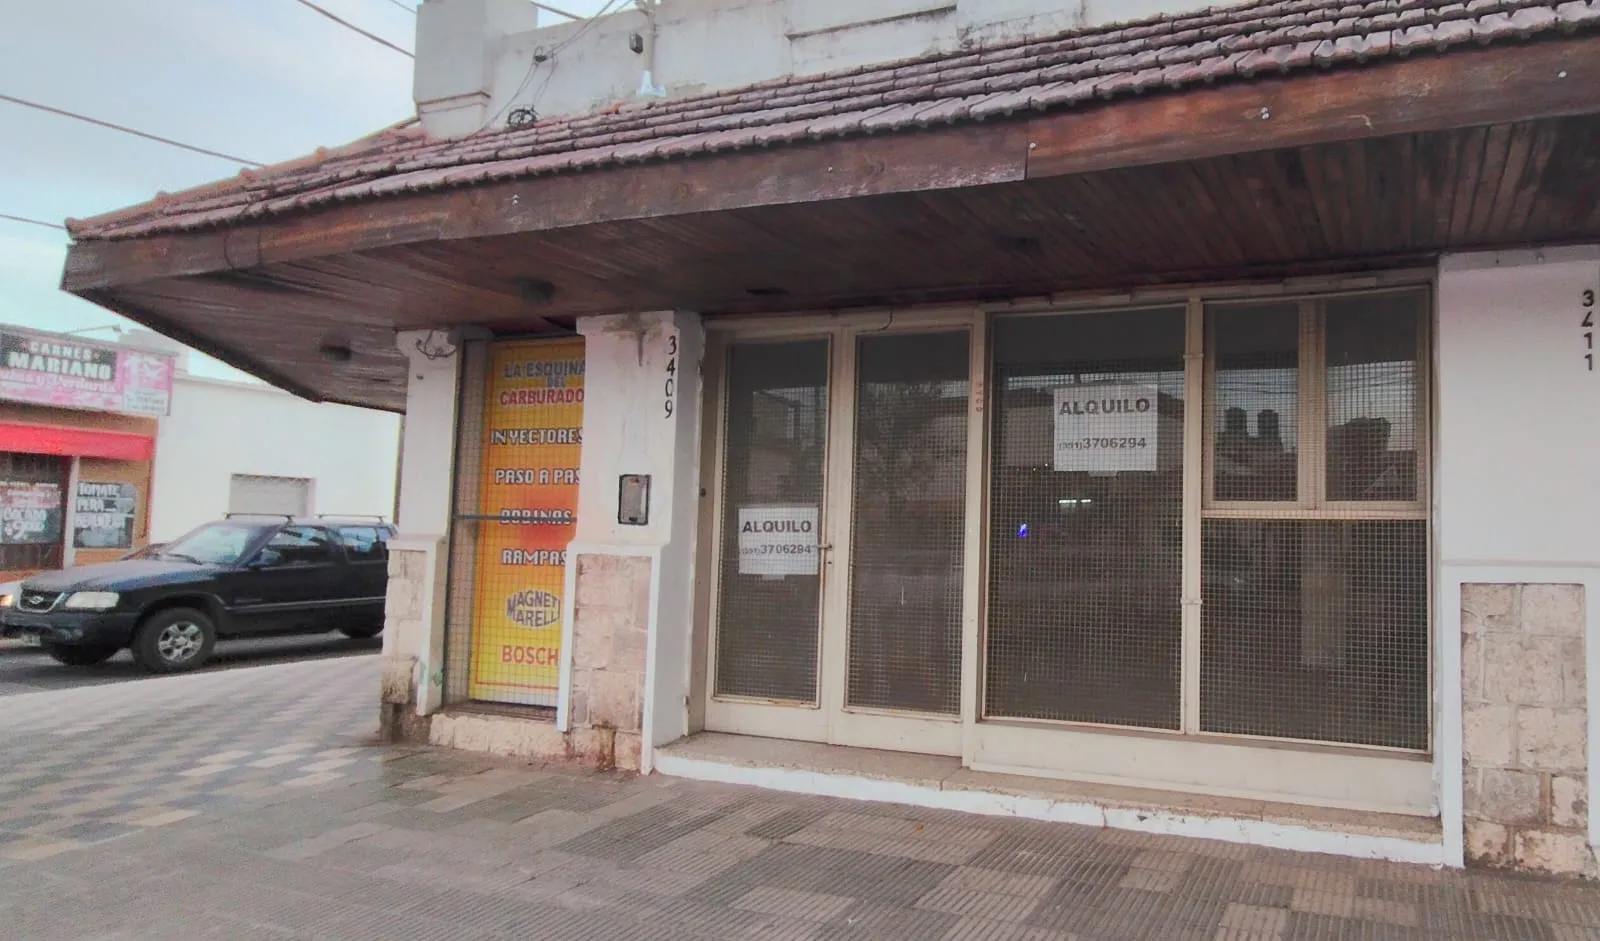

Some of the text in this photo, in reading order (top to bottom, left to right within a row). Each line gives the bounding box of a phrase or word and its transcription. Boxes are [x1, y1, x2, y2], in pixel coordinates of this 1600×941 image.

[1580, 289, 1594, 371] 3411
[29, 341, 92, 361] CARNES
[8, 351, 112, 380] MARIANO
[503, 362, 521, 378] LA
[664, 335, 677, 419] 3409
[1059, 399, 1150, 416] ALQUILO
[495, 468, 534, 485] PASO
[539, 469, 549, 484] A
[742, 520, 812, 533] ALQUILO
[502, 645, 558, 665] BOSCH
